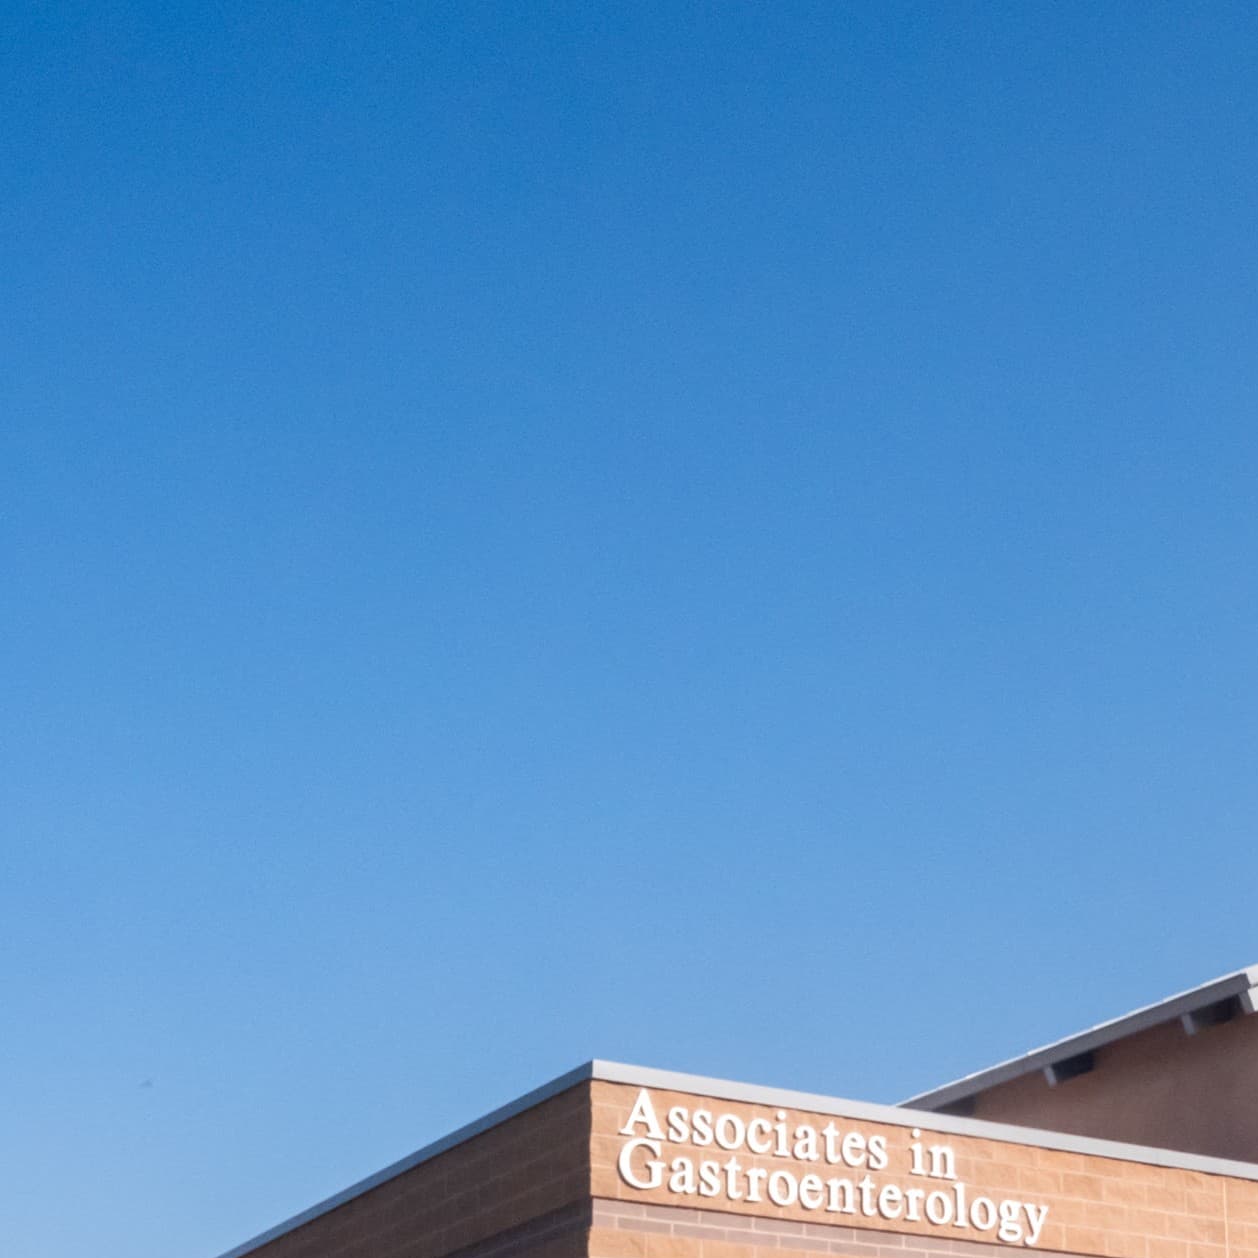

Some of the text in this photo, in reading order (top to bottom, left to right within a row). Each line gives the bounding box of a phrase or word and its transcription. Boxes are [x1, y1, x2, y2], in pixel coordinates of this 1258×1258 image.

[619, 1087, 958, 1180] Associates in
[618, 1136, 1049, 1246] Gastroenterology
